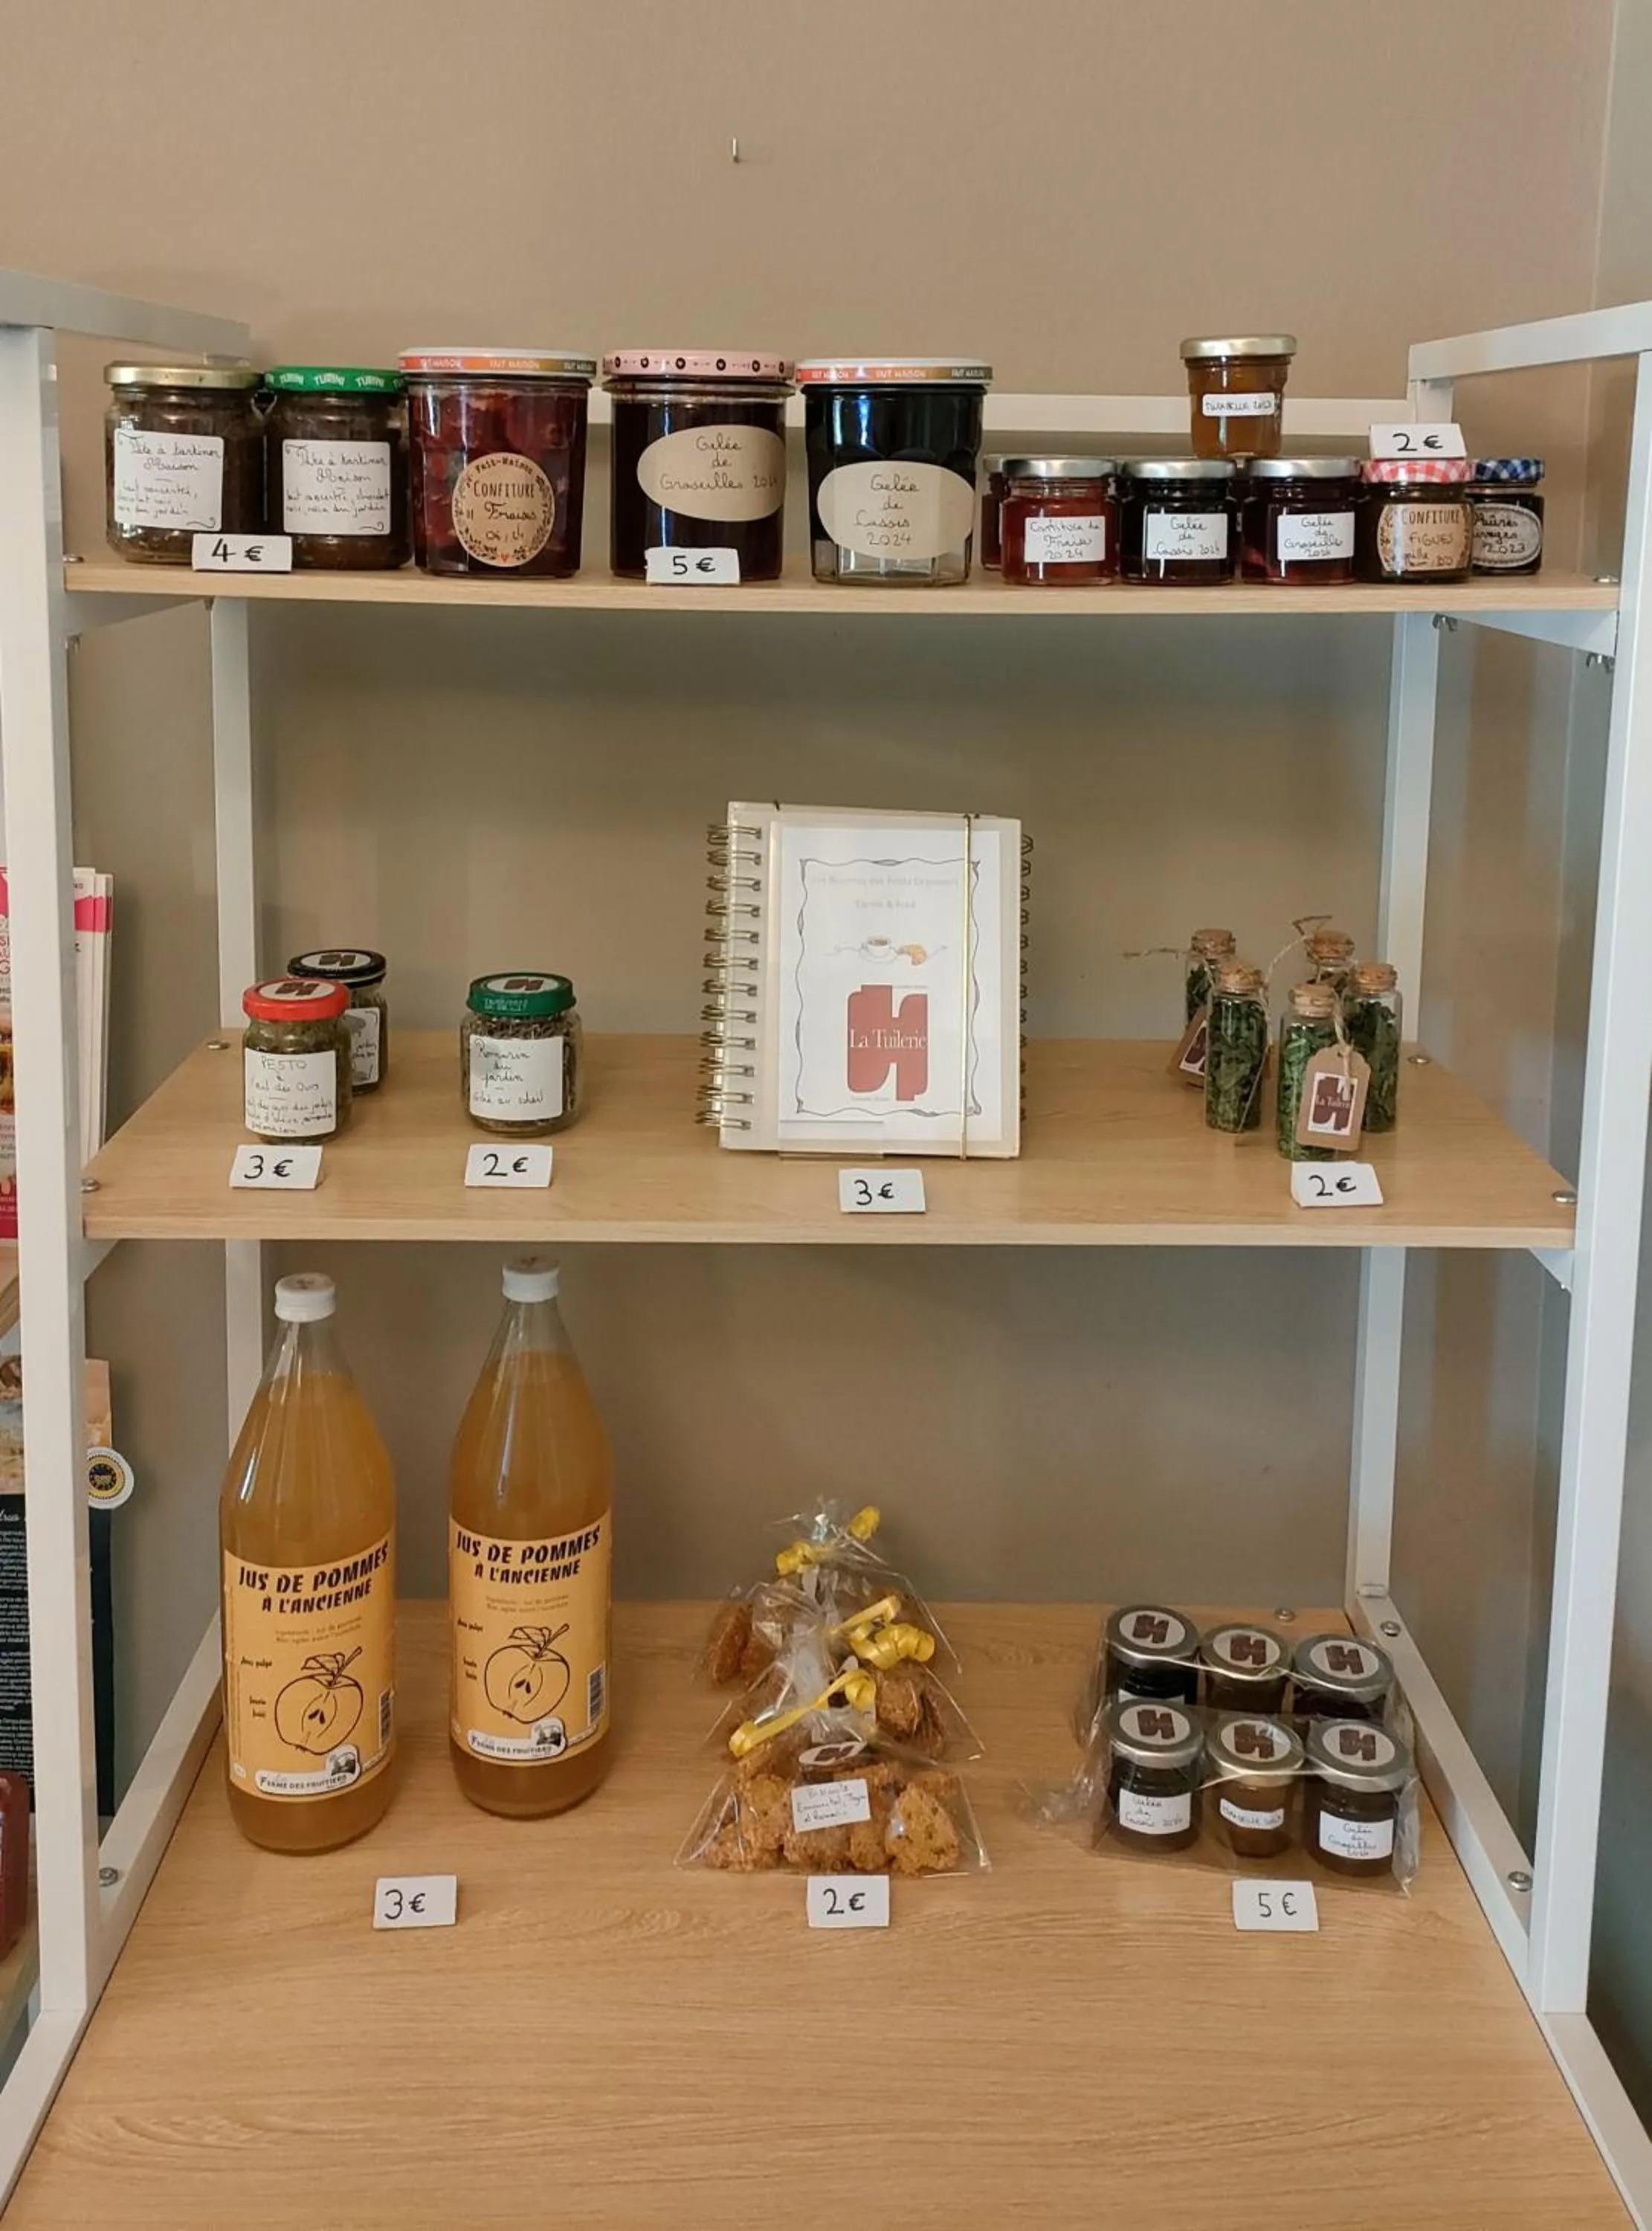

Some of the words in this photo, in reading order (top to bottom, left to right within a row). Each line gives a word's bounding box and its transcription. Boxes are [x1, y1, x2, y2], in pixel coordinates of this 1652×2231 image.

[473, 481, 535, 499] CONFITURE
[849, 1028, 868, 1049] La
[872, 1028, 928, 1049] Tuilerie
[261, 1056, 307, 1072] PESTO
[456, 1530, 482, 1557] JUS
[487, 1543, 513, 1565] DE
[520, 1523, 601, 1565] POMMES
[239, 1565, 269, 1591] JUS
[276, 1573, 304, 1594] DE
[312, 1539, 390, 1592] POMMES
[489, 1558, 581, 1585] L'ANCIENNE
[279, 1577, 372, 1615] L'ANCIENNE
